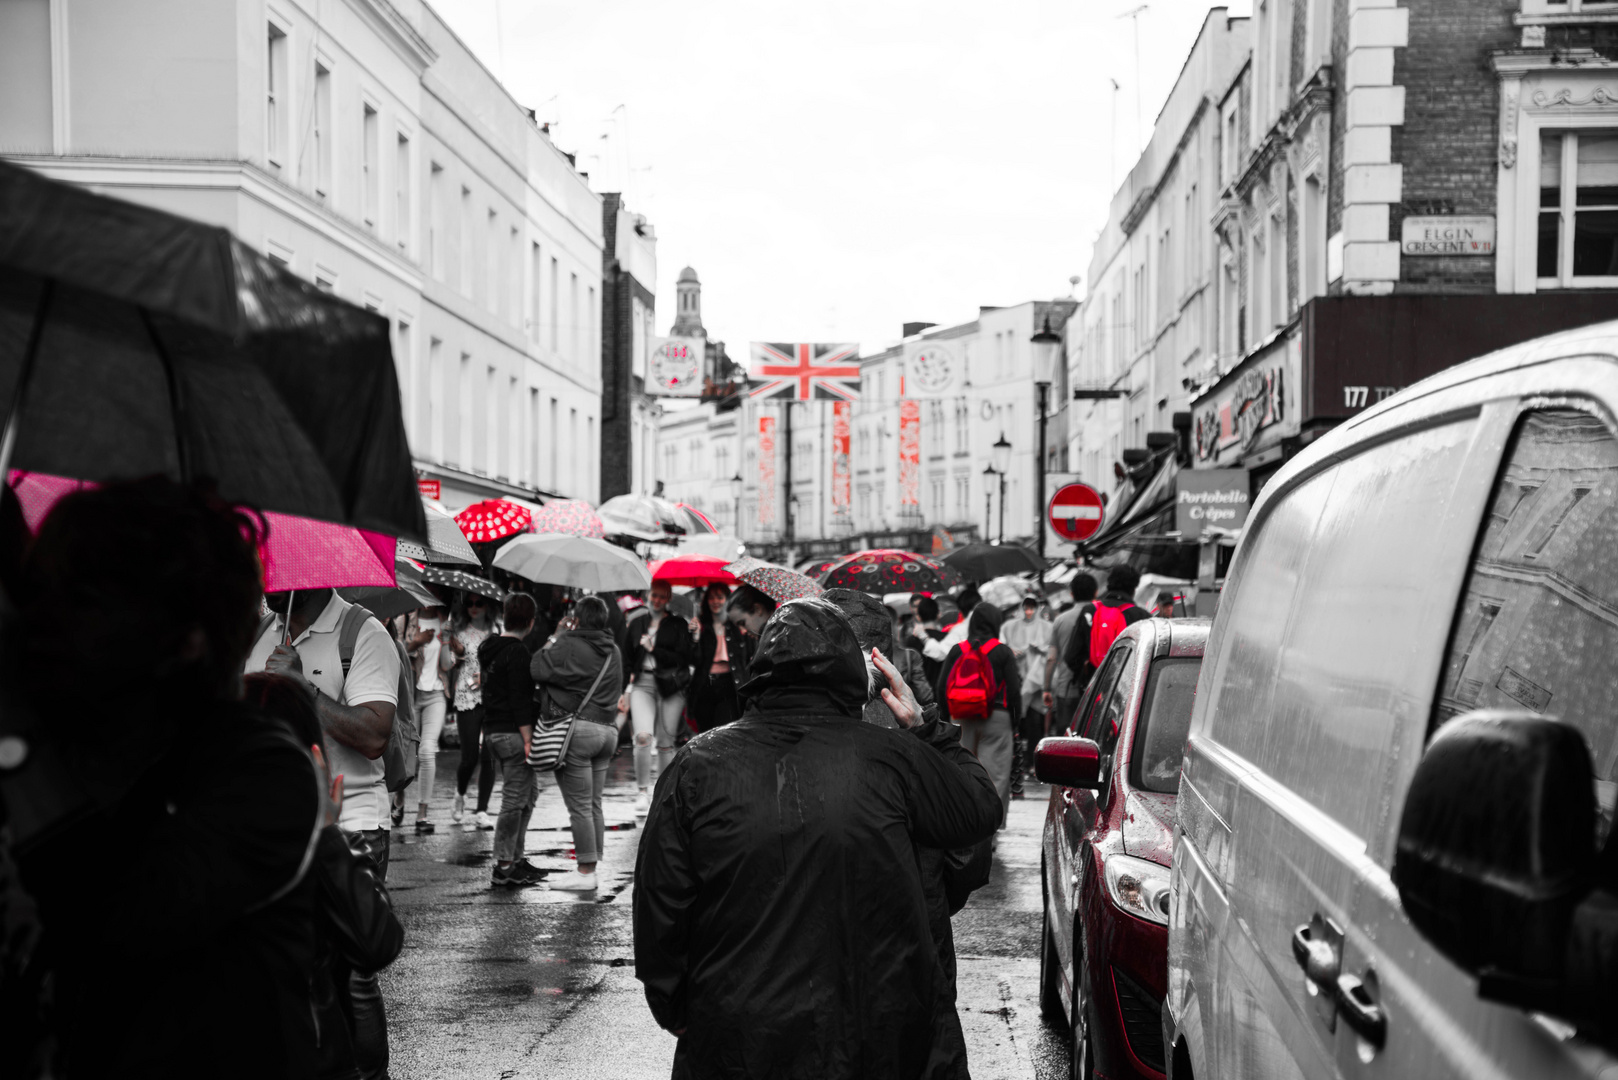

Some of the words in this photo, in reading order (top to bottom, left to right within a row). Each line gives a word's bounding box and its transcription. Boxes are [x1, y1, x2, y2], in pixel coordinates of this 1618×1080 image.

[1424, 228, 1474, 241] ELGIN
[1344, 386, 1369, 408] 177
[1178, 489, 1248, 504] Portobello
